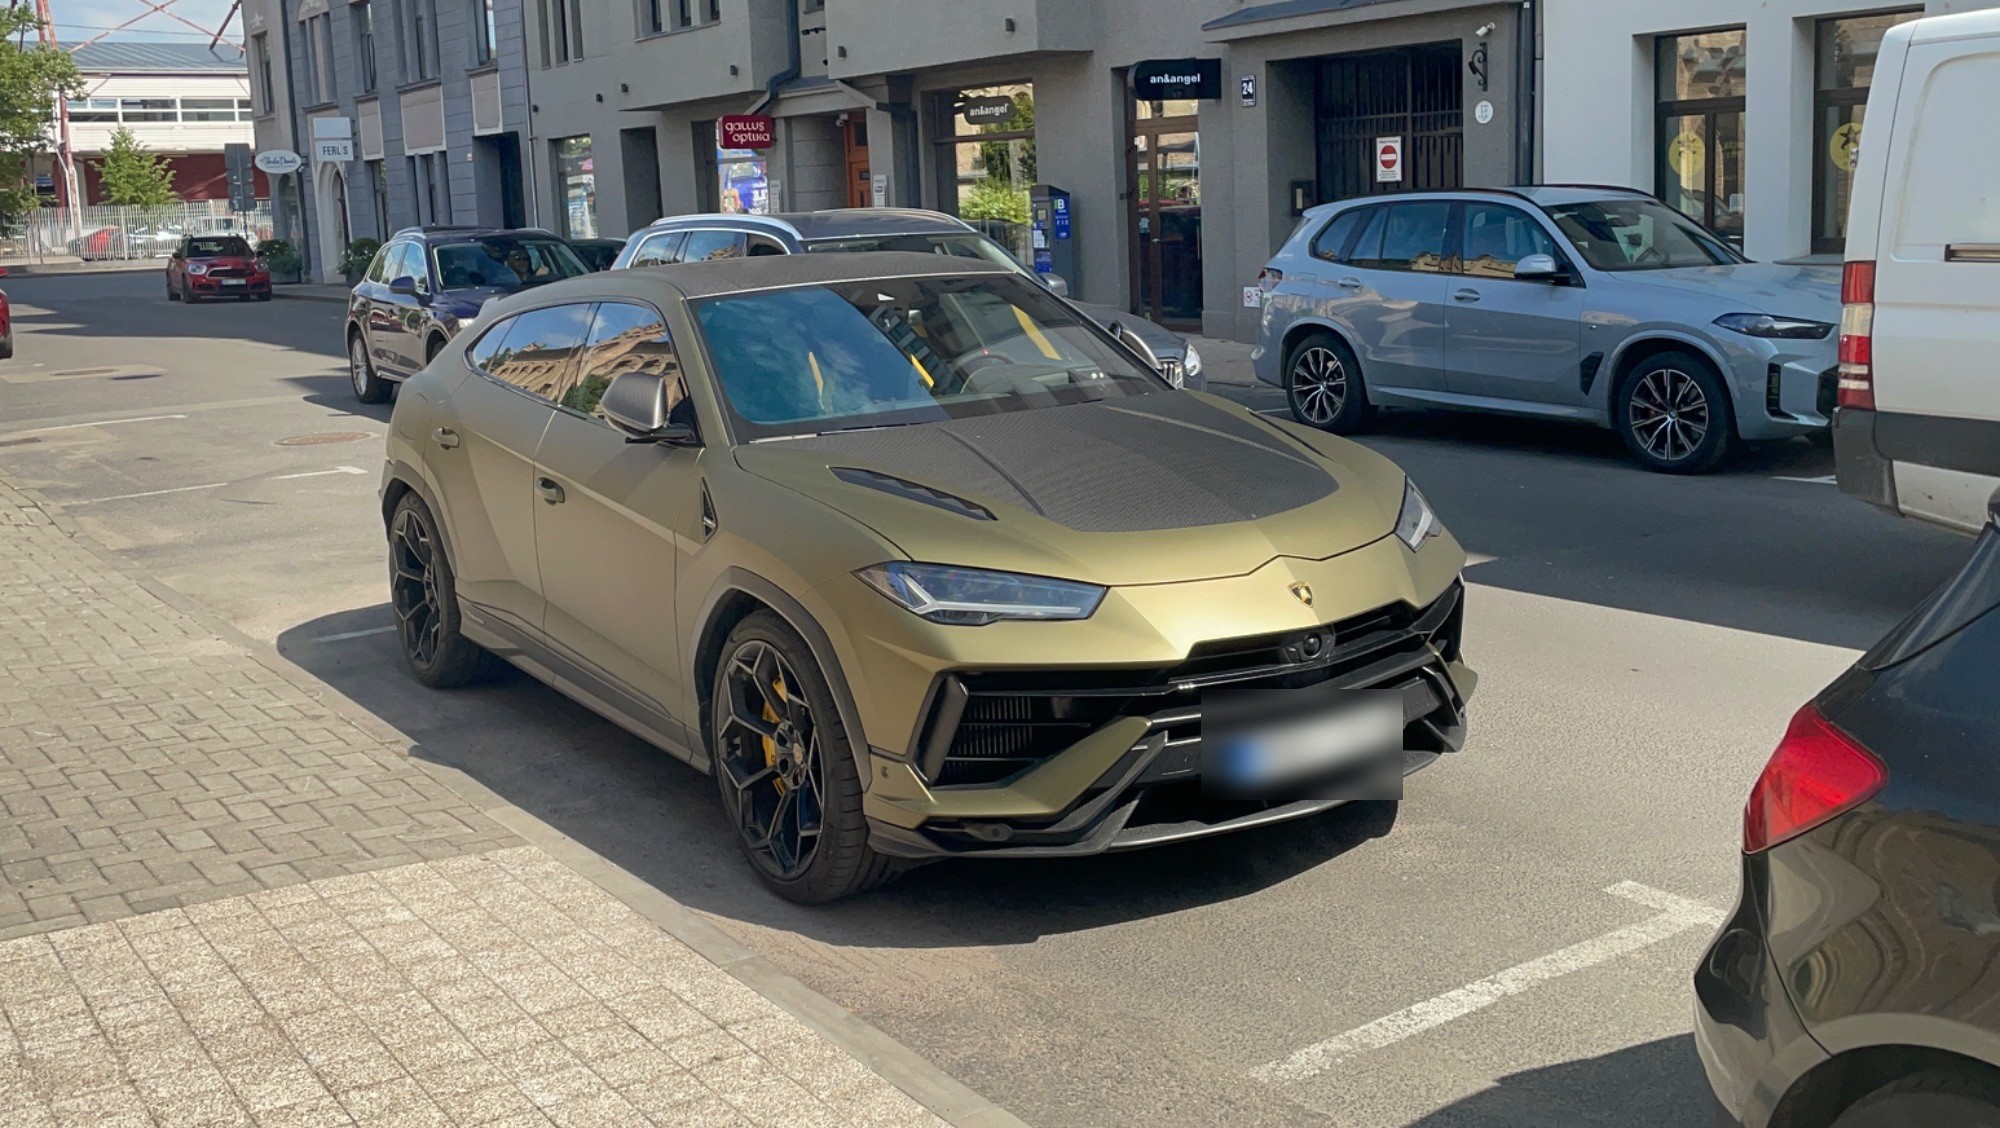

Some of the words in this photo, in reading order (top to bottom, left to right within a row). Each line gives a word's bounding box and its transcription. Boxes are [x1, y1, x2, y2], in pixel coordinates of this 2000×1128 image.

[1149, 73, 1201, 85] an&angel
[1242, 81, 1253, 95] 24
[969, 102, 1009, 116] an&angel
[725, 121, 765, 134] gallus
[732, 132, 770, 144] optika
